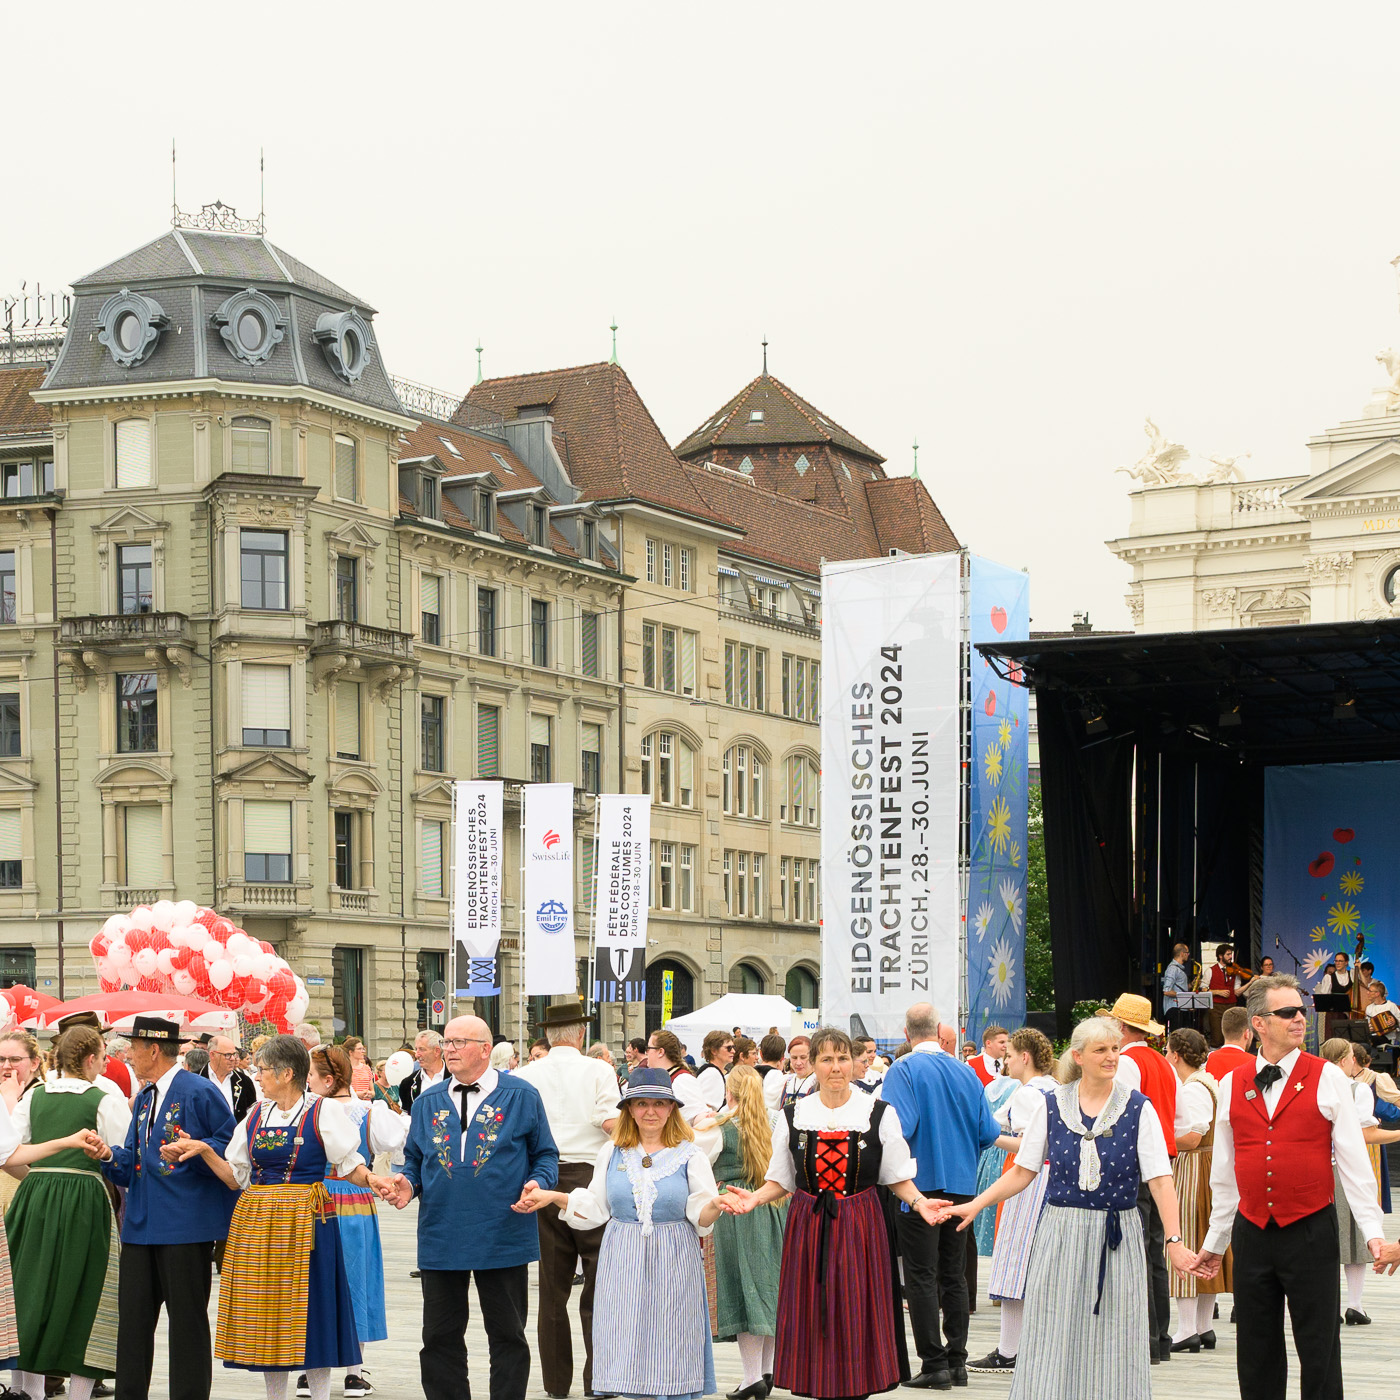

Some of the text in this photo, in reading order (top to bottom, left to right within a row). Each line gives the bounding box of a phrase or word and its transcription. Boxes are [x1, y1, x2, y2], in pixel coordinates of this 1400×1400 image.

[466, 808, 477, 929] EIDGENÖSSISCHES
[477, 794, 489, 929] TRACHTENFEST 2024
[619, 806, 632, 937] DES COSTUMES 2024
[846, 682, 874, 994] EIDGENÖSSISCHES
[880, 643, 903, 995] TRACHTENFEST 2024
[607, 841, 621, 937] FÊTE FÉDÉRALE
[908, 888, 930, 992] ZÜRICH,
